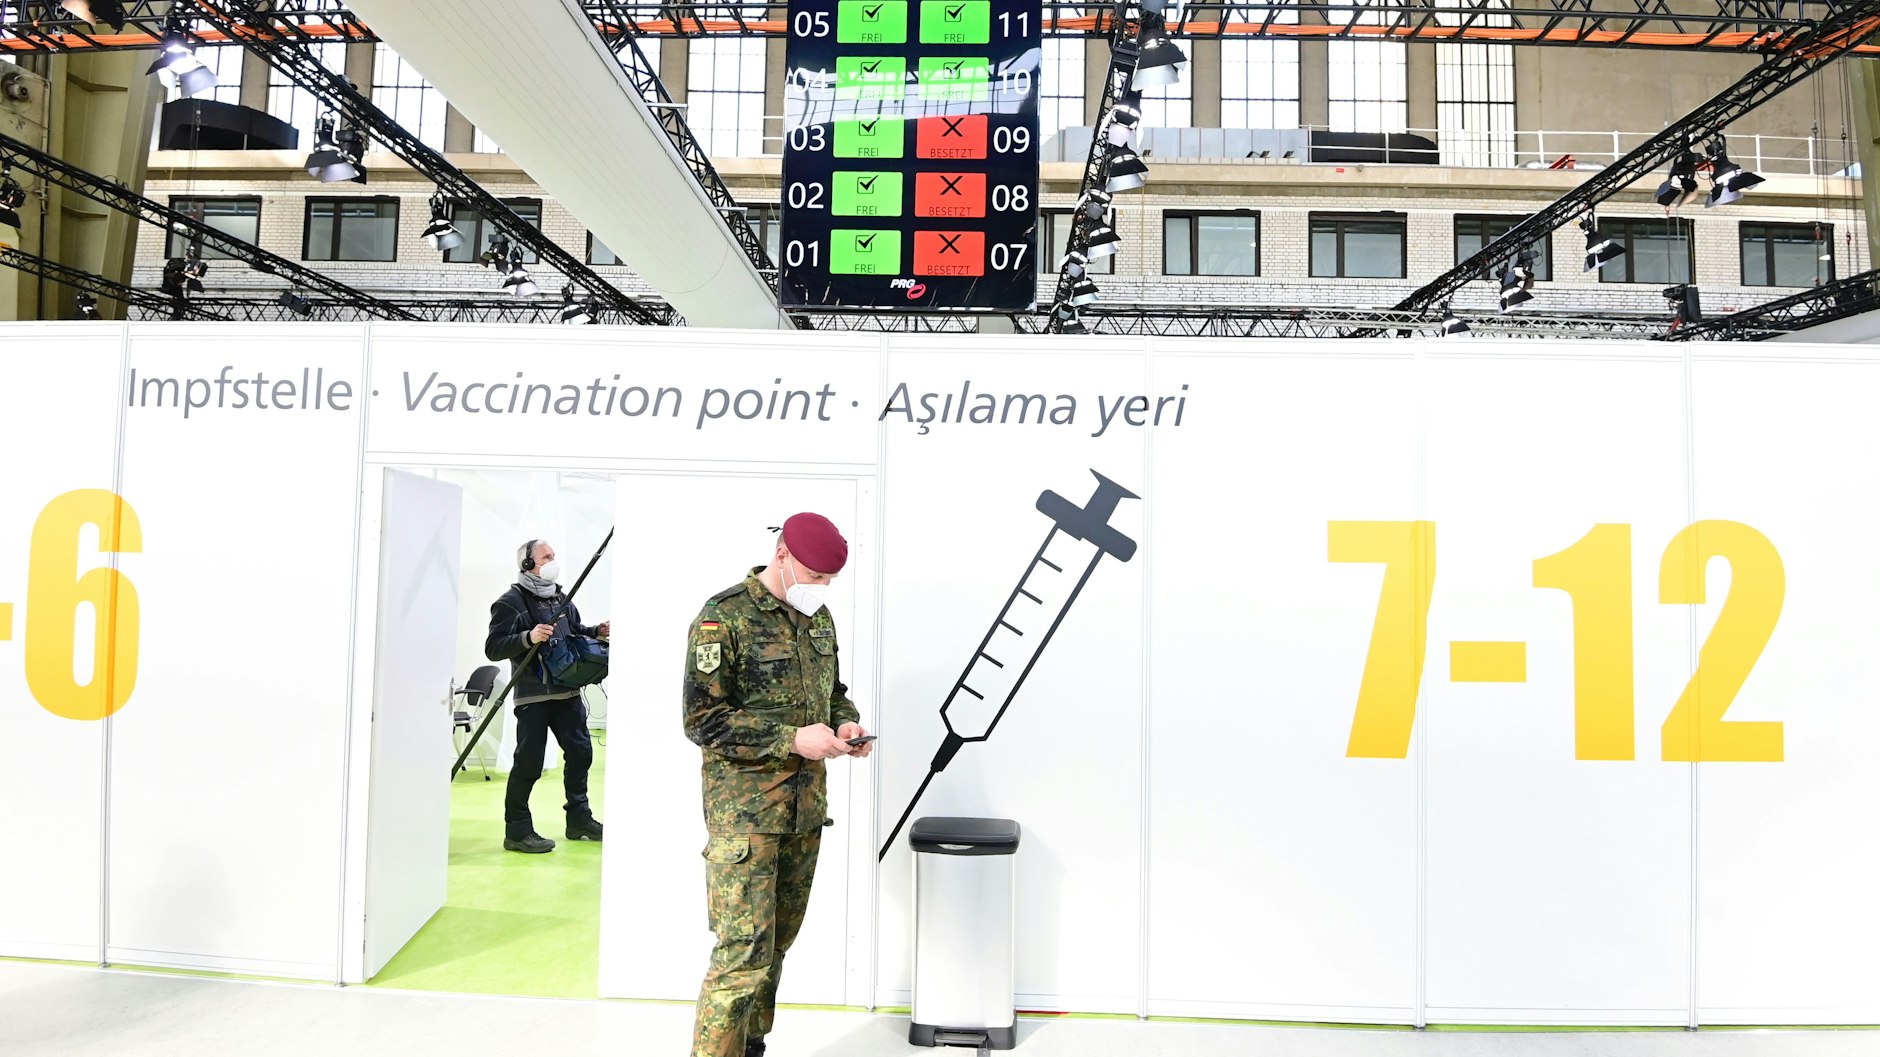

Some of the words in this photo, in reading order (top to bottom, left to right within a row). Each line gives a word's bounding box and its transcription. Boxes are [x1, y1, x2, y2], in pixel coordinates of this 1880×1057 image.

[794, 11, 830, 38] 05
[998, 12, 1028, 37] 11
[861, 33, 882, 42] FREI
[944, 33, 965, 42] FREI
[792, 68, 828, 93] 04
[998, 69, 1032, 95] 10
[790, 125, 826, 151] 03
[993, 126, 1030, 154] 09
[857, 147, 879, 157] FREI
[930, 148, 973, 158] BESETZT
[788, 182, 824, 209] 02
[991, 185, 1029, 212] 08
[856, 205, 877, 215] FREI
[928, 207, 972, 216] BESETZT
[786, 240, 819, 267] 01
[990, 243, 1028, 270] 07
[854, 263, 876, 273] FREI
[927, 265, 971, 275] BESETZT
[890, 278, 916, 289] PRG
[128, 365, 353, 419] Impfstelle
[403, 371, 682, 418] Vaccination
[696, 377, 837, 430] point
[878, 381, 1078, 436] Aşılama
[1090, 384, 1190, 438] yeri
[1327, 519, 1786, 763] 7-12
